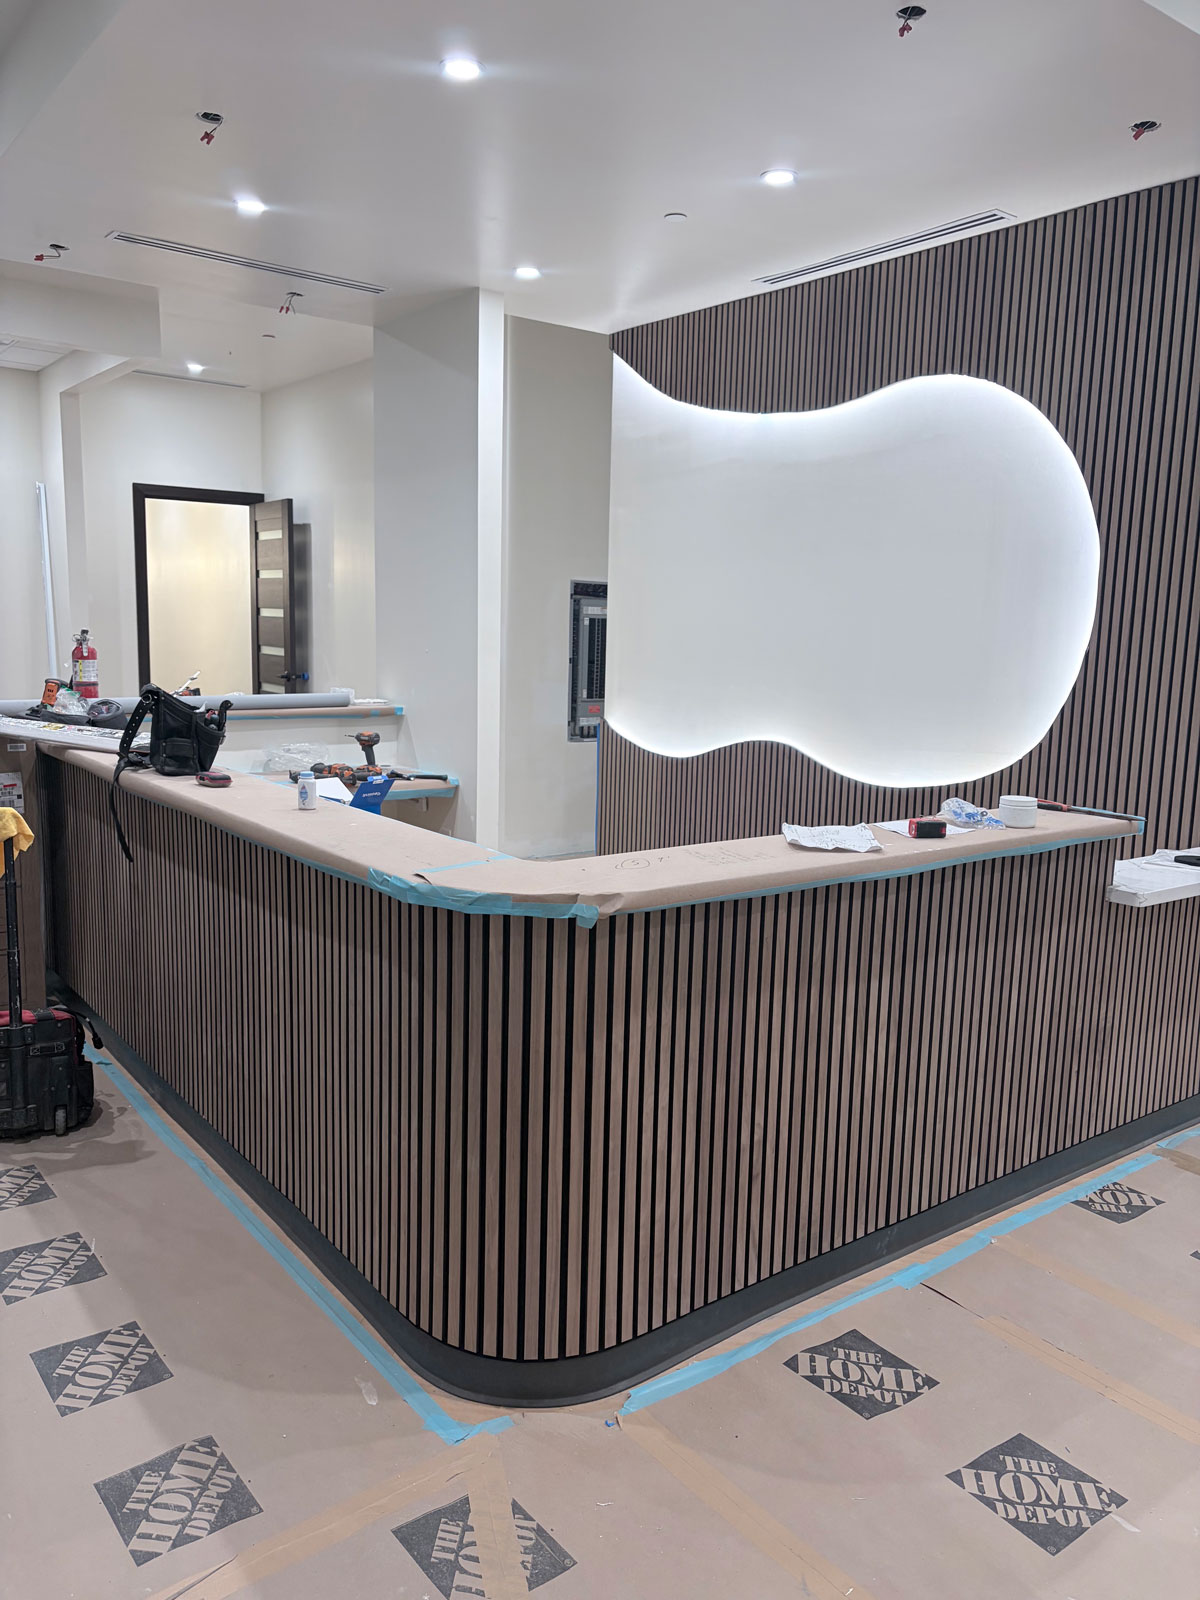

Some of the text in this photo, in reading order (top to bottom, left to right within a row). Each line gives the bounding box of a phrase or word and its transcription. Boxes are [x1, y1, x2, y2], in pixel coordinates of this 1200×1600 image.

[1089, 1203, 1131, 1214] THE
[2, 1250, 38, 1275] THE
[2, 1236, 83, 1297] HOME
[45, 1248, 93, 1288] DEPOT
[52, 1345, 92, 1377] THE
[54, 1327, 142, 1408] HOME
[103, 1343, 156, 1396] DEPOT
[798, 1352, 929, 1393] HOME
[833, 1347, 883, 1365] THE
[821, 1377, 908, 1406] DEPOT
[1000, 1454, 1059, 1477] THE
[122, 1470, 166, 1513] THE
[127, 1442, 220, 1553] HOME
[182, 1465, 238, 1538] DEPOT
[960, 1467, 1118, 1512] HOME
[994, 1501, 1093, 1528] DEPOT
[431, 1517, 464, 1563] THE
